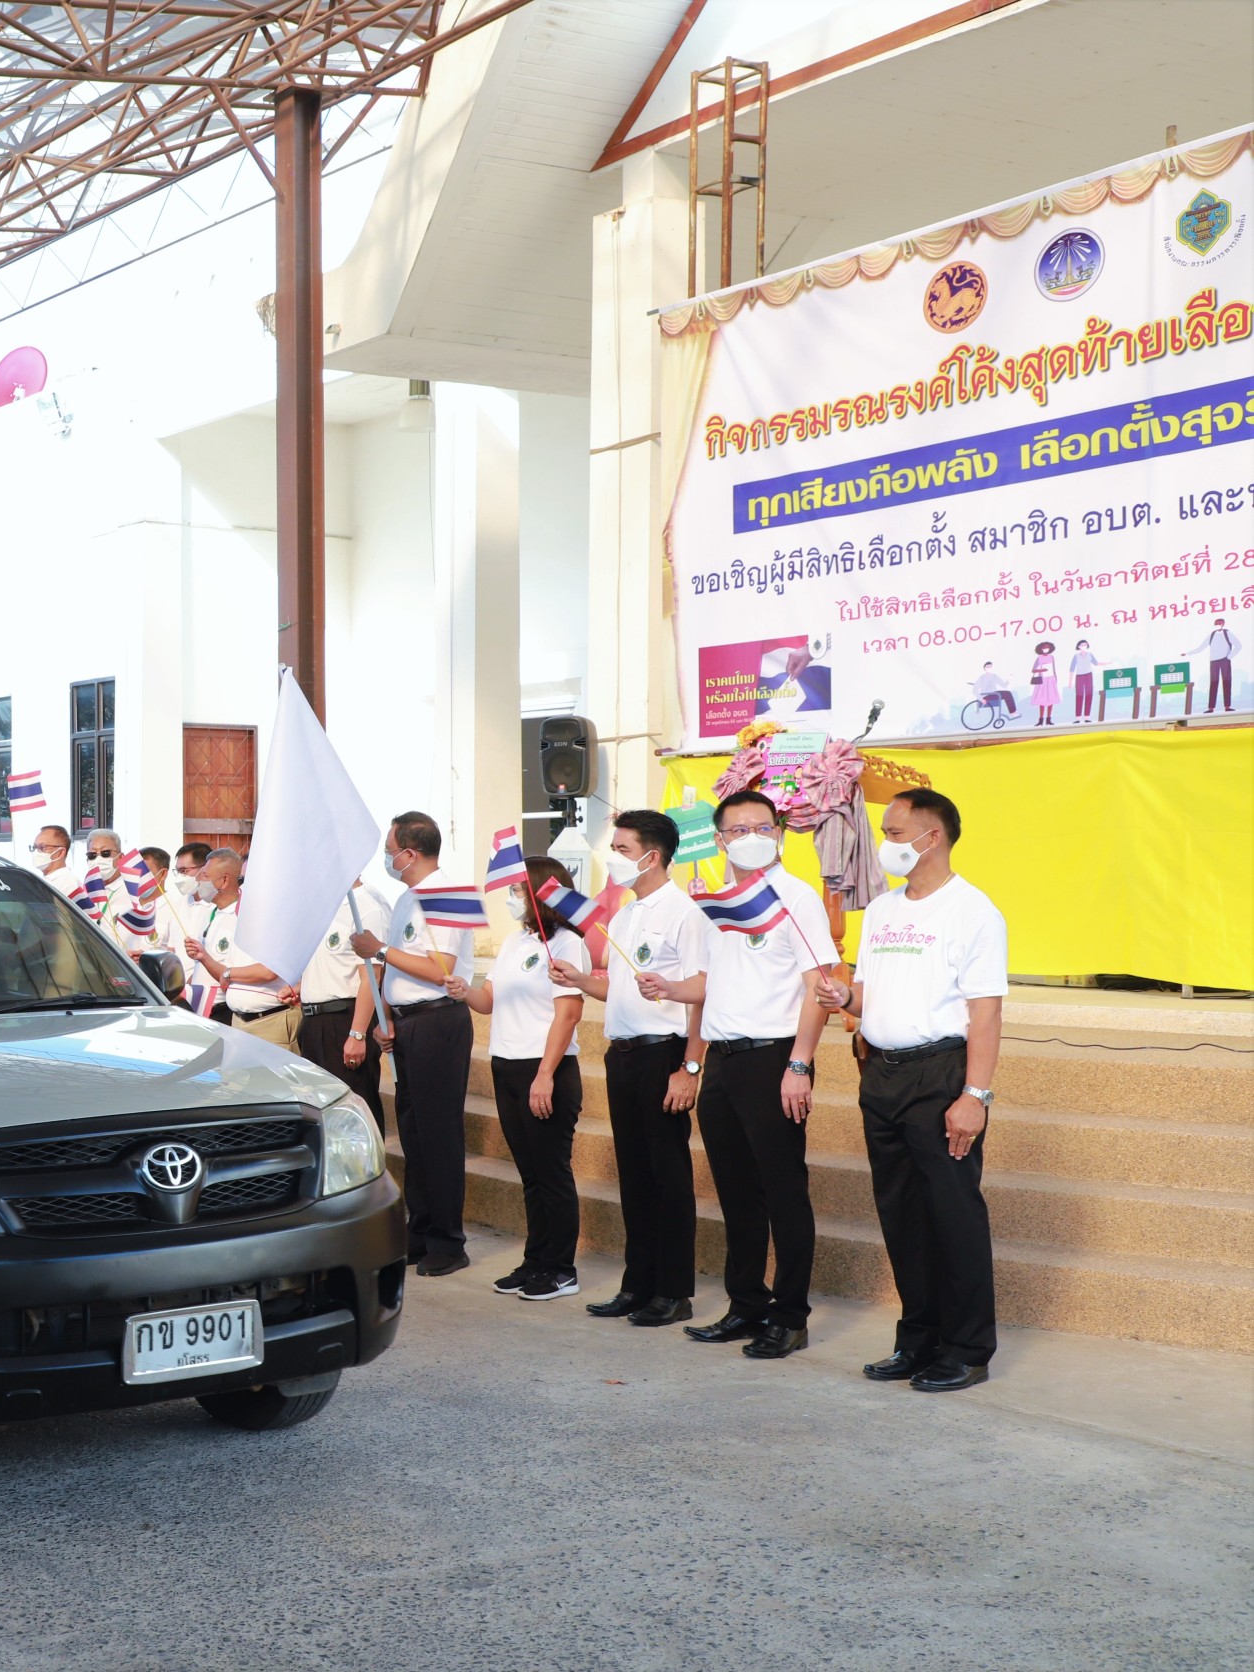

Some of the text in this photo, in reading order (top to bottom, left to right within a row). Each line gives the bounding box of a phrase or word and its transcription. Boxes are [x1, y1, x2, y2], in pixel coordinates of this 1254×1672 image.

[748, 448, 999, 527] ทุกเสียงคือพลัง
[691, 510, 956, 596] ขอเชิญผู้มีสิทธิเลือกตั้ง
[968, 509, 1069, 553] สมาชิก
[1082, 502, 1161, 536] อบต.
[837, 571, 1021, 622] ไปใช้สิทธิเลือกตั้ง
[1028, 544, 1212, 597] ในวันอาทิตย์ที่
[863, 636, 910, 653] เวลา
[1073, 612, 1099, 629] น.
[1111, 608, 1138, 625] ณ
[705, 671, 755, 688] เราคนไทย
[136, 1310, 246, 1353] กข 9901
[176, 1353, 210, 1367] ยโสธร
